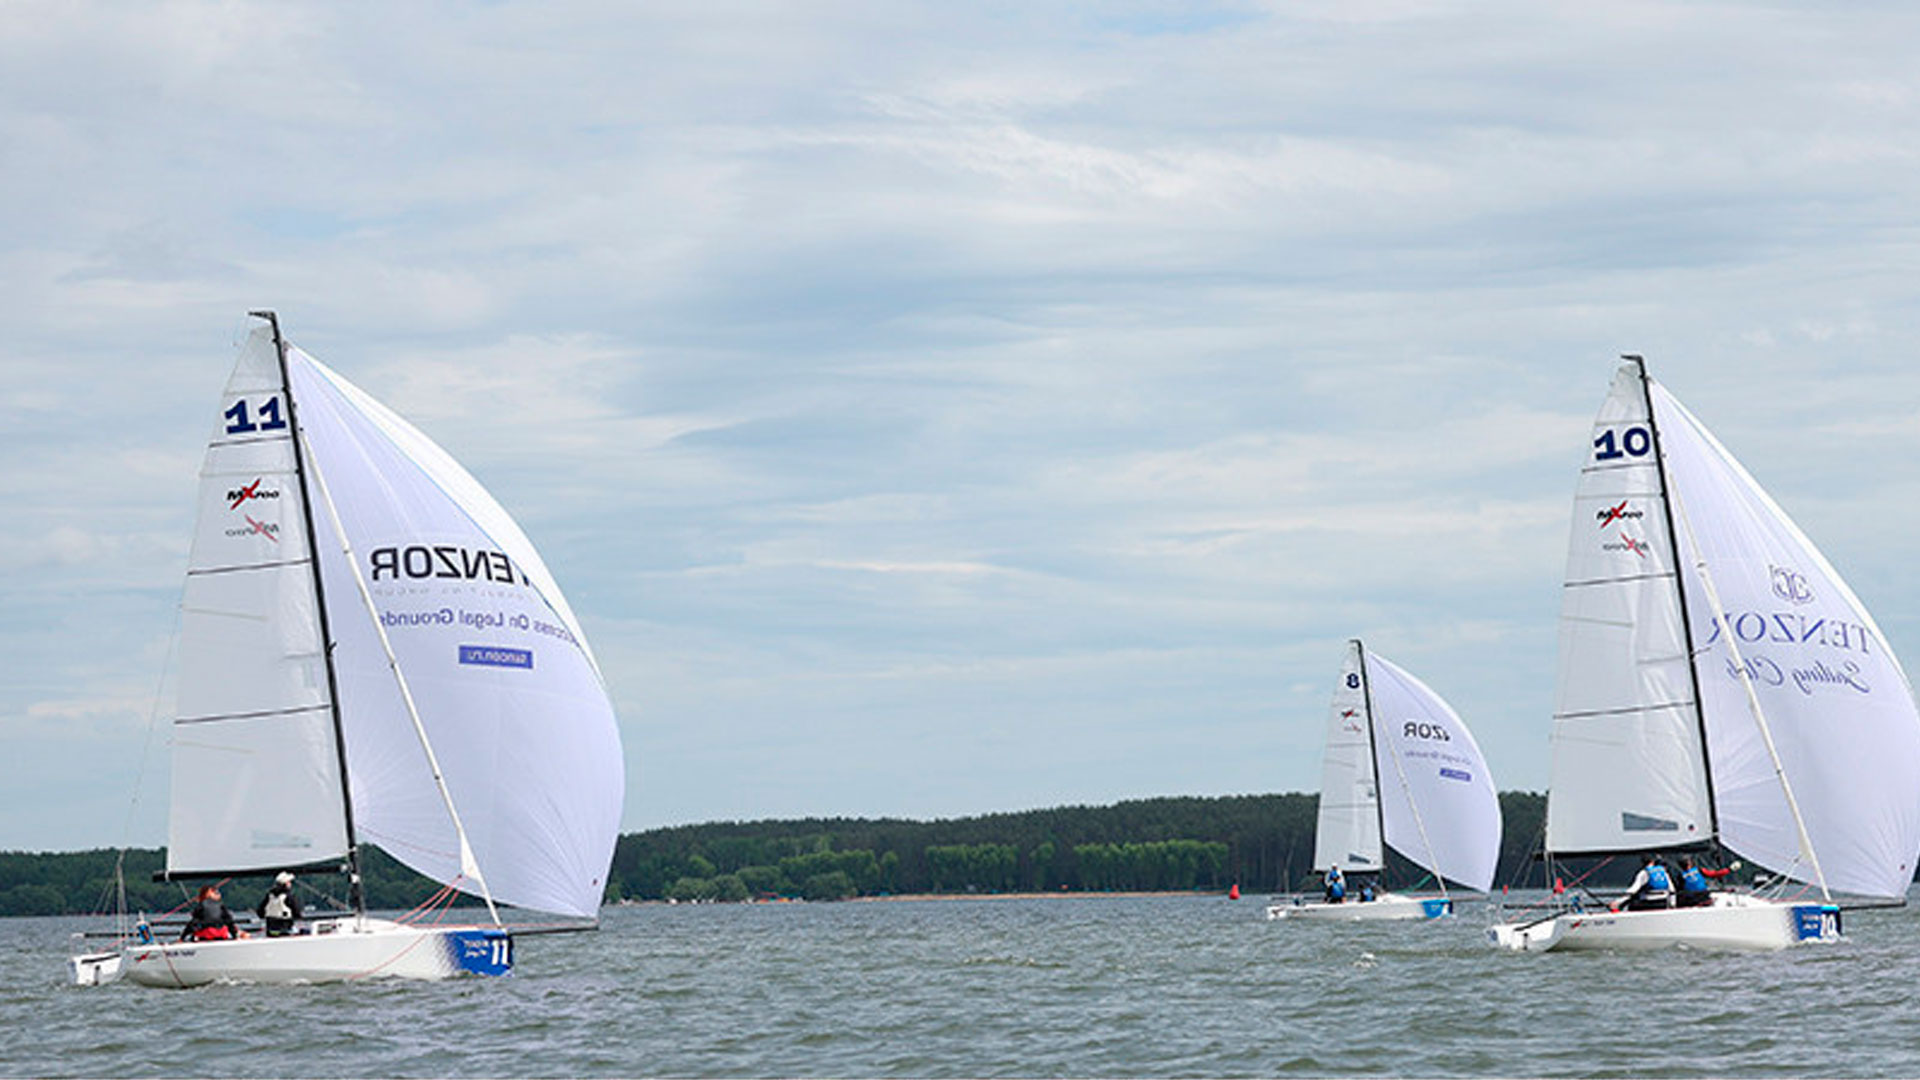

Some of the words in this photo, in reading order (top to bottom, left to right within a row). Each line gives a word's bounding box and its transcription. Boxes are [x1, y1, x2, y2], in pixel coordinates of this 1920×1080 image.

[224, 396, 287, 434] 11
[1594, 427, 1650, 460] 10
[1346, 673, 1360, 689] 8
[491, 939, 509, 966] 11
